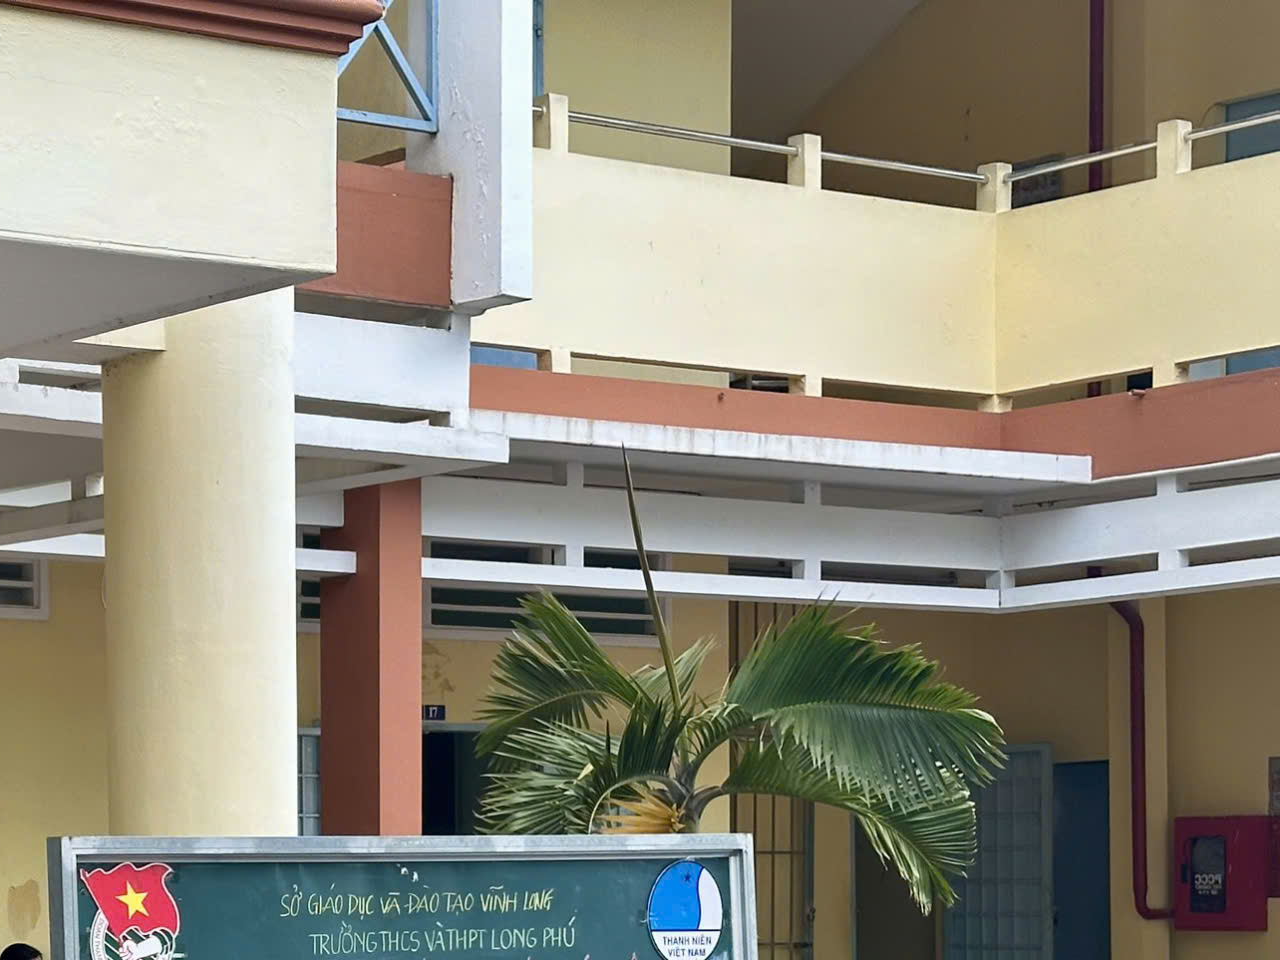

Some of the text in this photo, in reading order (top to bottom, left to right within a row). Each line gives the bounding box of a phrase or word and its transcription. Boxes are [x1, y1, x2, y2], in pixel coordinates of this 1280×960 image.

[428, 706, 438, 718] 17
[280, 885, 302, 917] SỞ
[308, 883, 343, 916] GIÁO
[348, 894, 375, 920] DỤC
[441, 892, 475, 916] TẠO
[480, 885, 518, 912] VĨNH
[523, 888, 554, 911] LONG
[309, 921, 377, 955] TRƯỜNG
[379, 930, 420, 952] THCS
[490, 928, 537, 951] LONG
[543, 916, 576, 949] PHÚ
[663, 934, 712, 946] THANH NIÊN
[667, 946, 706, 958] VIỆT NAM
